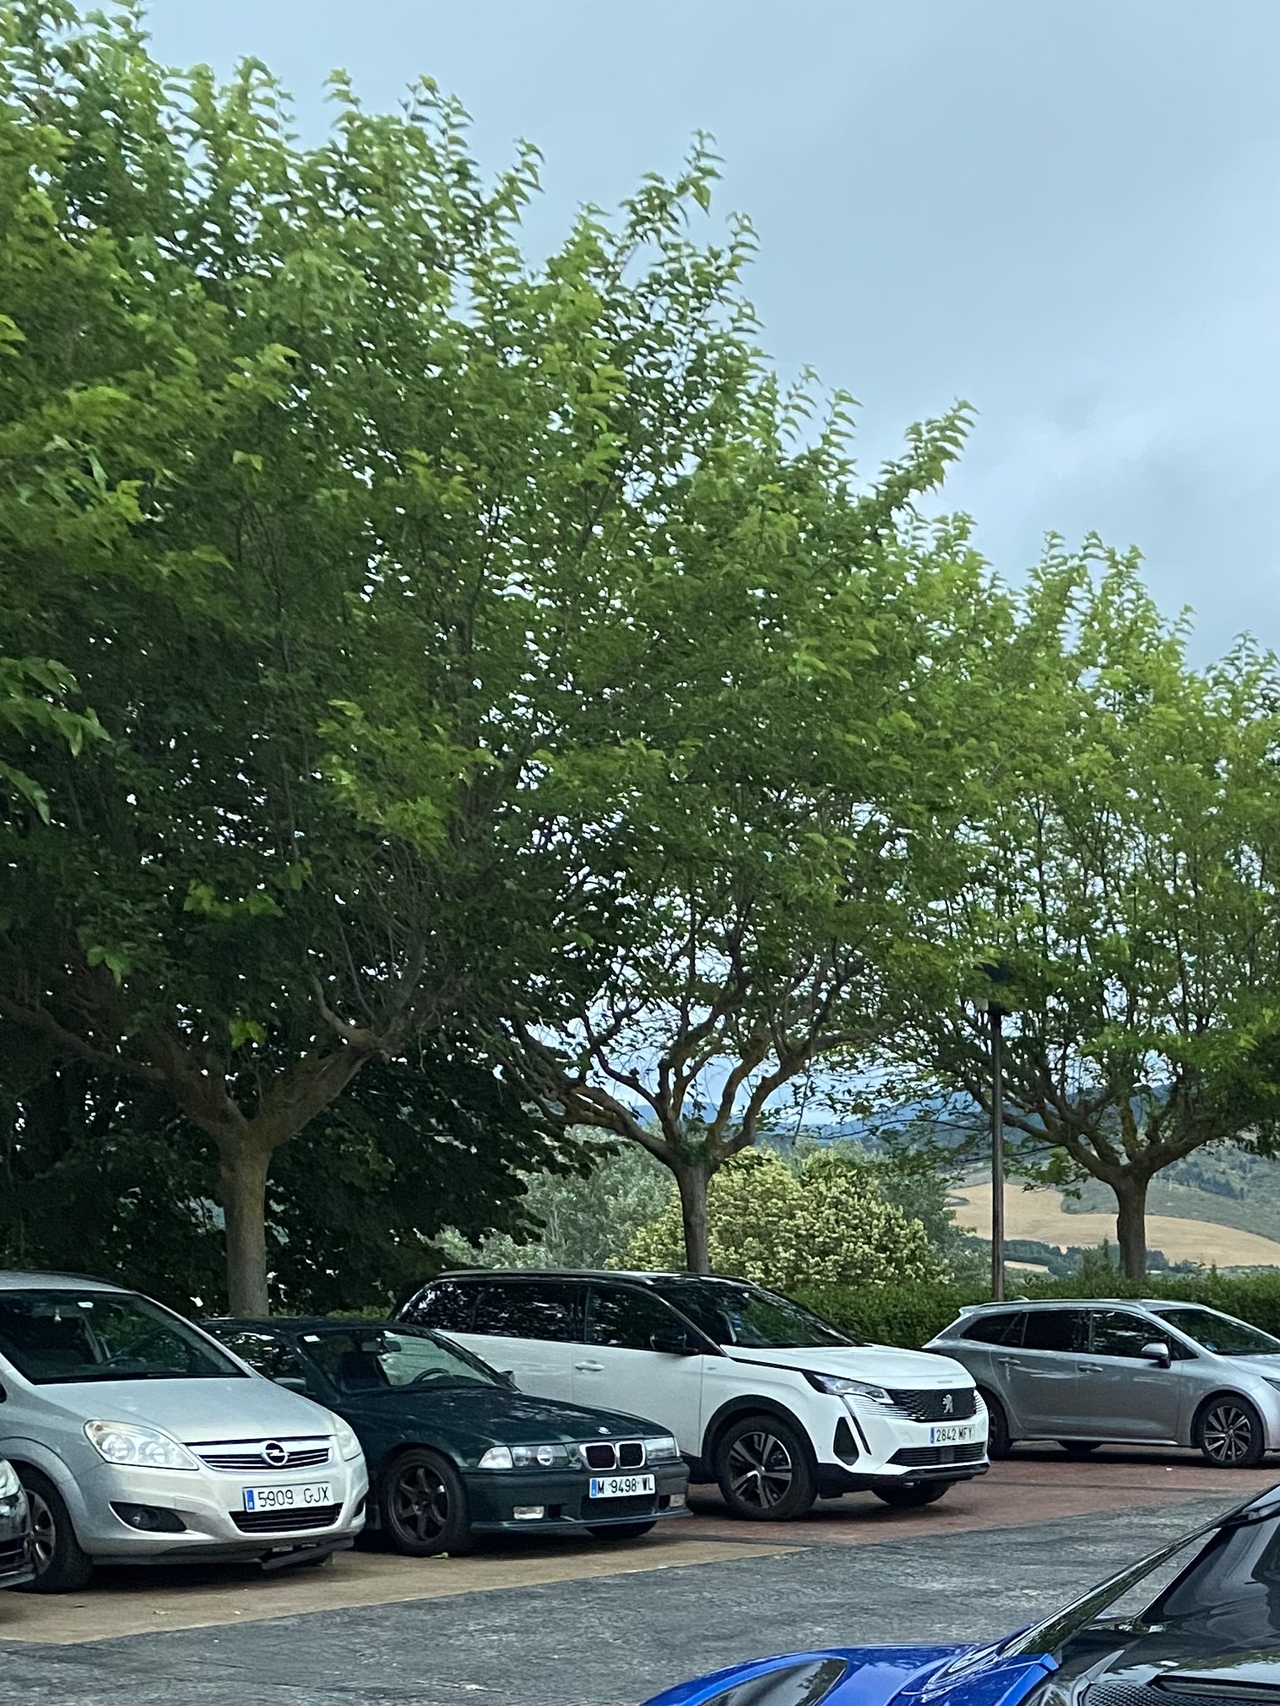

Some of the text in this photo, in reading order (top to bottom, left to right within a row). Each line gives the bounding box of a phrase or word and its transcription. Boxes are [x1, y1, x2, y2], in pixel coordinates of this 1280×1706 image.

[936, 1428, 957, 1442] 2842
[597, 1480, 605, 1494] M
[610, 1478, 637, 1494] 9498
[257, 1486, 330, 1508] 5909 GJX
